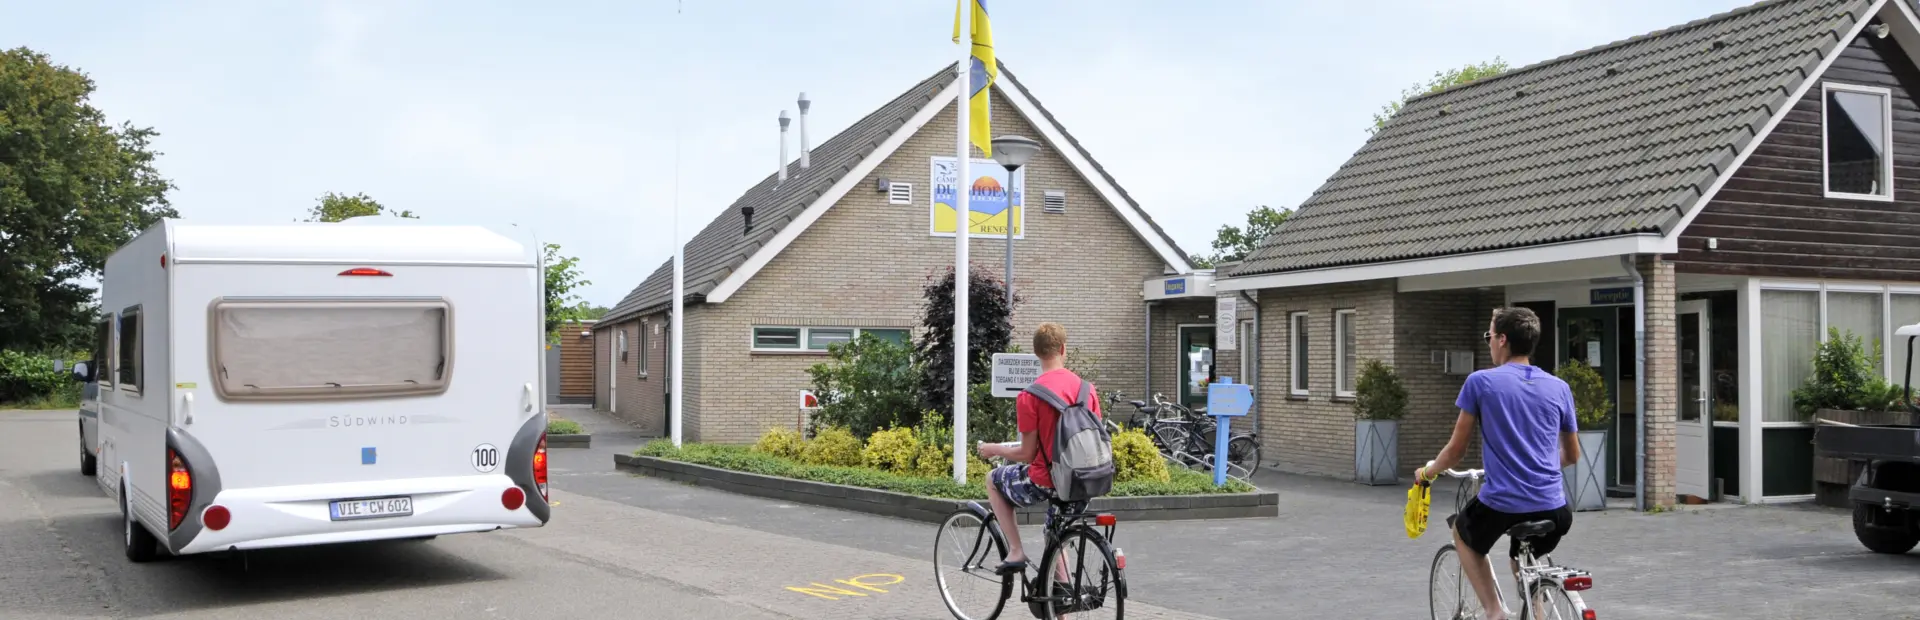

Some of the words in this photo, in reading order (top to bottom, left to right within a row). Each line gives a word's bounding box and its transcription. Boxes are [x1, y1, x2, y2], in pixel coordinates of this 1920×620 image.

[936, 176, 957, 184] CAMP
[936, 184, 1020, 198] DUHOEV
[980, 225, 1018, 234] RENESE
[330, 414, 407, 428] SÜDWIND
[475, 448, 497, 467] 100
[338, 502, 361, 516] VIE
[369, 501, 384, 514] CW
[387, 499, 409, 513] 602
